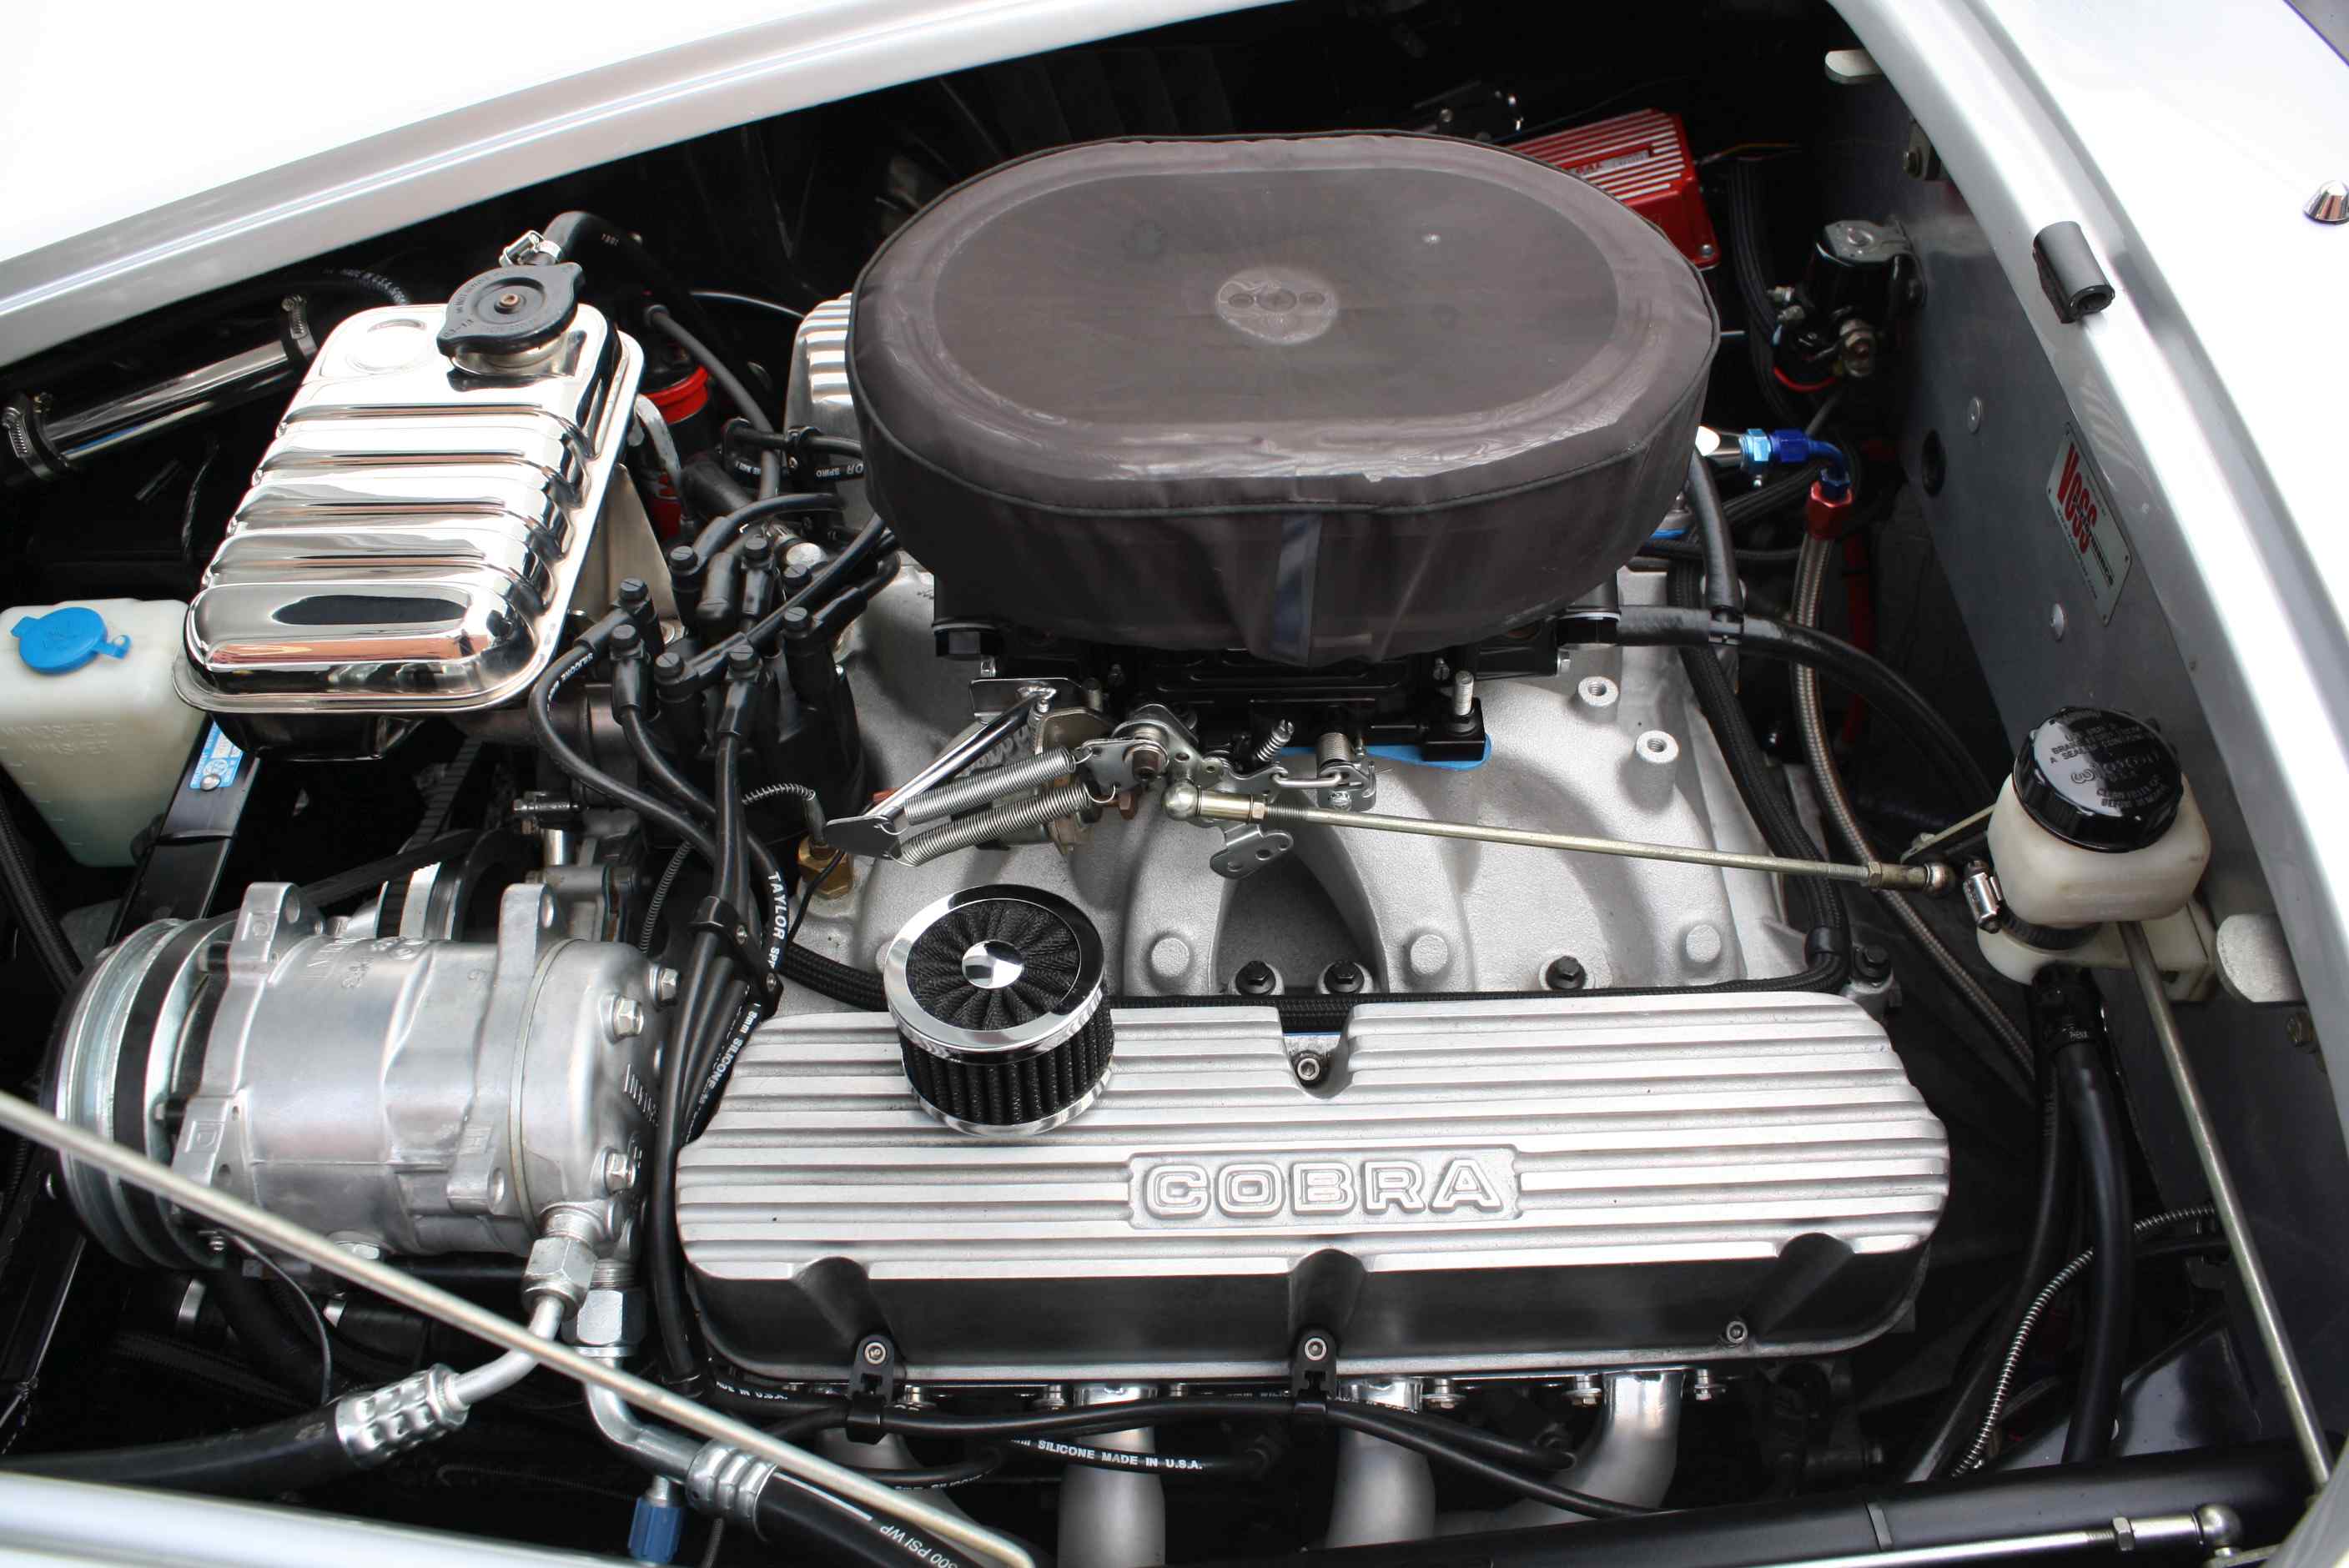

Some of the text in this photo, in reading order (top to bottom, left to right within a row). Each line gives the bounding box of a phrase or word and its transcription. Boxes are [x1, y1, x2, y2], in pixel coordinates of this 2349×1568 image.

[767, 870, 787, 941] TAYLOR
[708, 1037, 744, 1090] SILICONE
[1144, 1158, 1504, 1219] COBRA
[1037, 1440, 1096, 1460] SILICONE
[1101, 1451, 1139, 1466] MADE
[1145, 1457, 1159, 1468] IN
[1165, 1458, 1203, 1470] U.S.A.
[879, 1525, 907, 1544] WP
[904, 1537, 933, 1559] PSI
